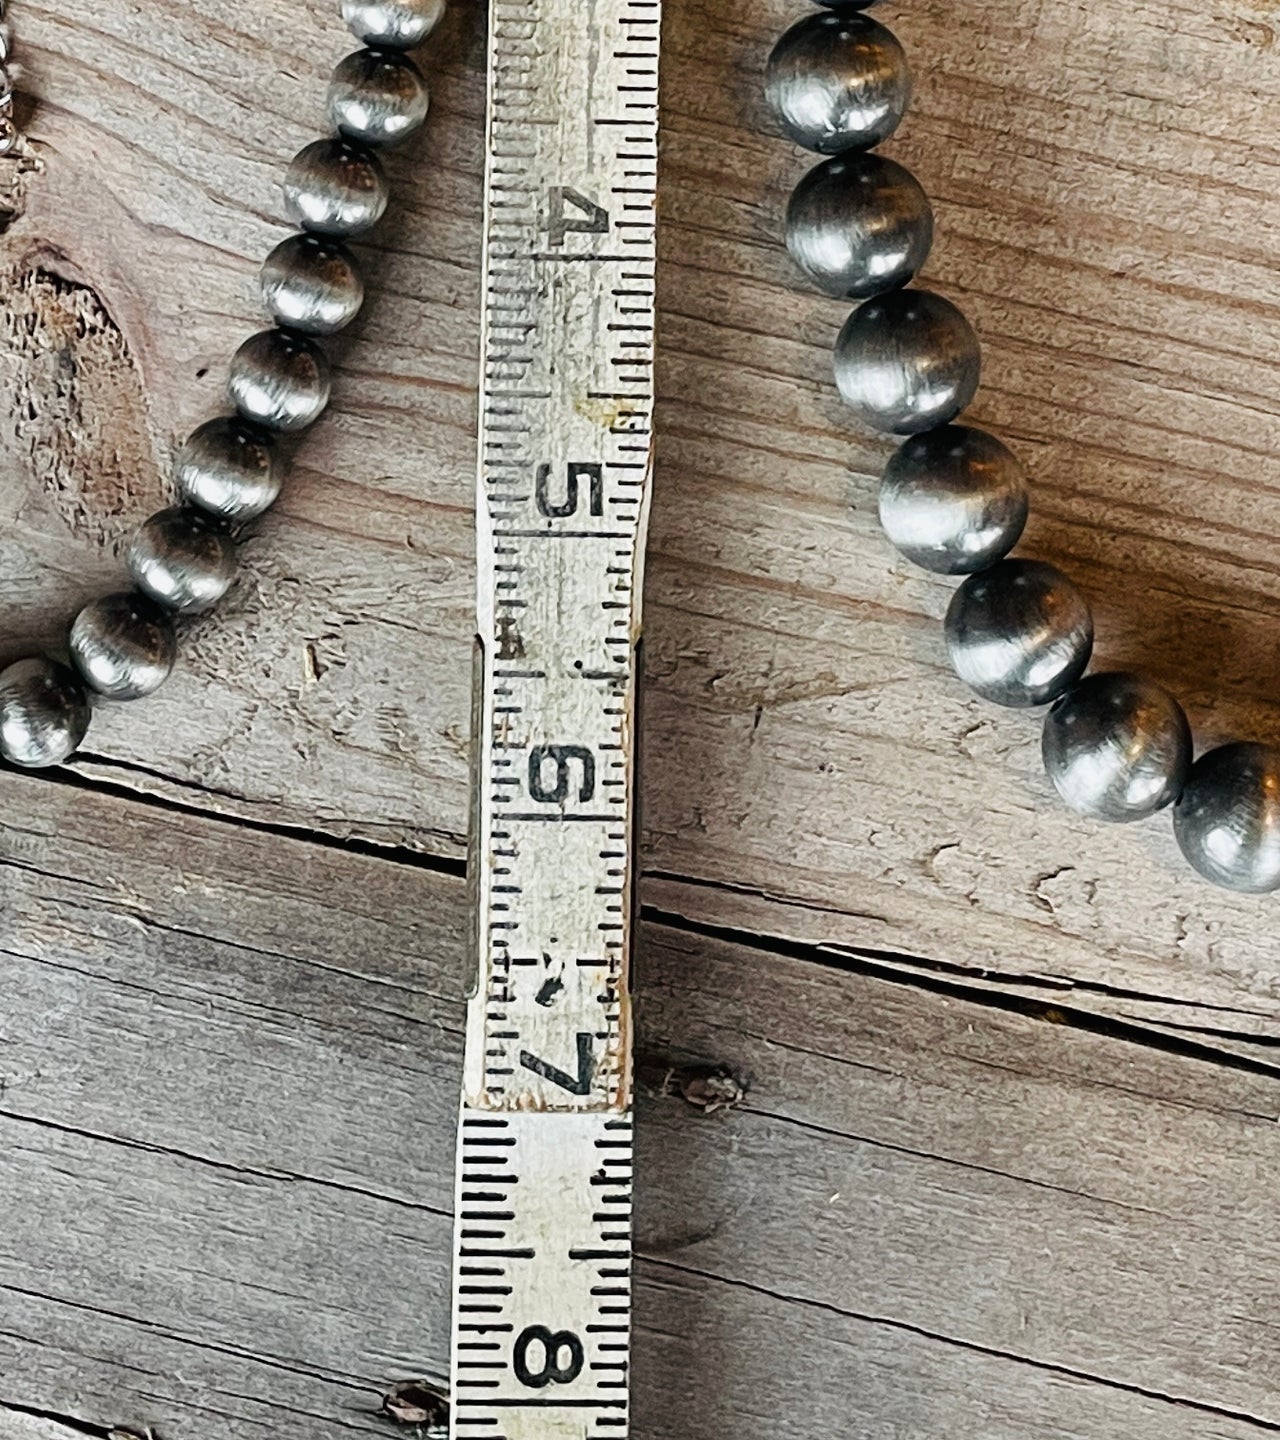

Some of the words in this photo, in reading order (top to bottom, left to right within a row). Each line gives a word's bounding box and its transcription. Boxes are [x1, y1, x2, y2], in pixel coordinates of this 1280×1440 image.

[545, 185, 611, 246] 4
[535, 462, 604, 518] 5
[528, 744, 596, 804] 6
[520, 1031, 593, 1096] 7
[513, 1324, 584, 1388] 8
